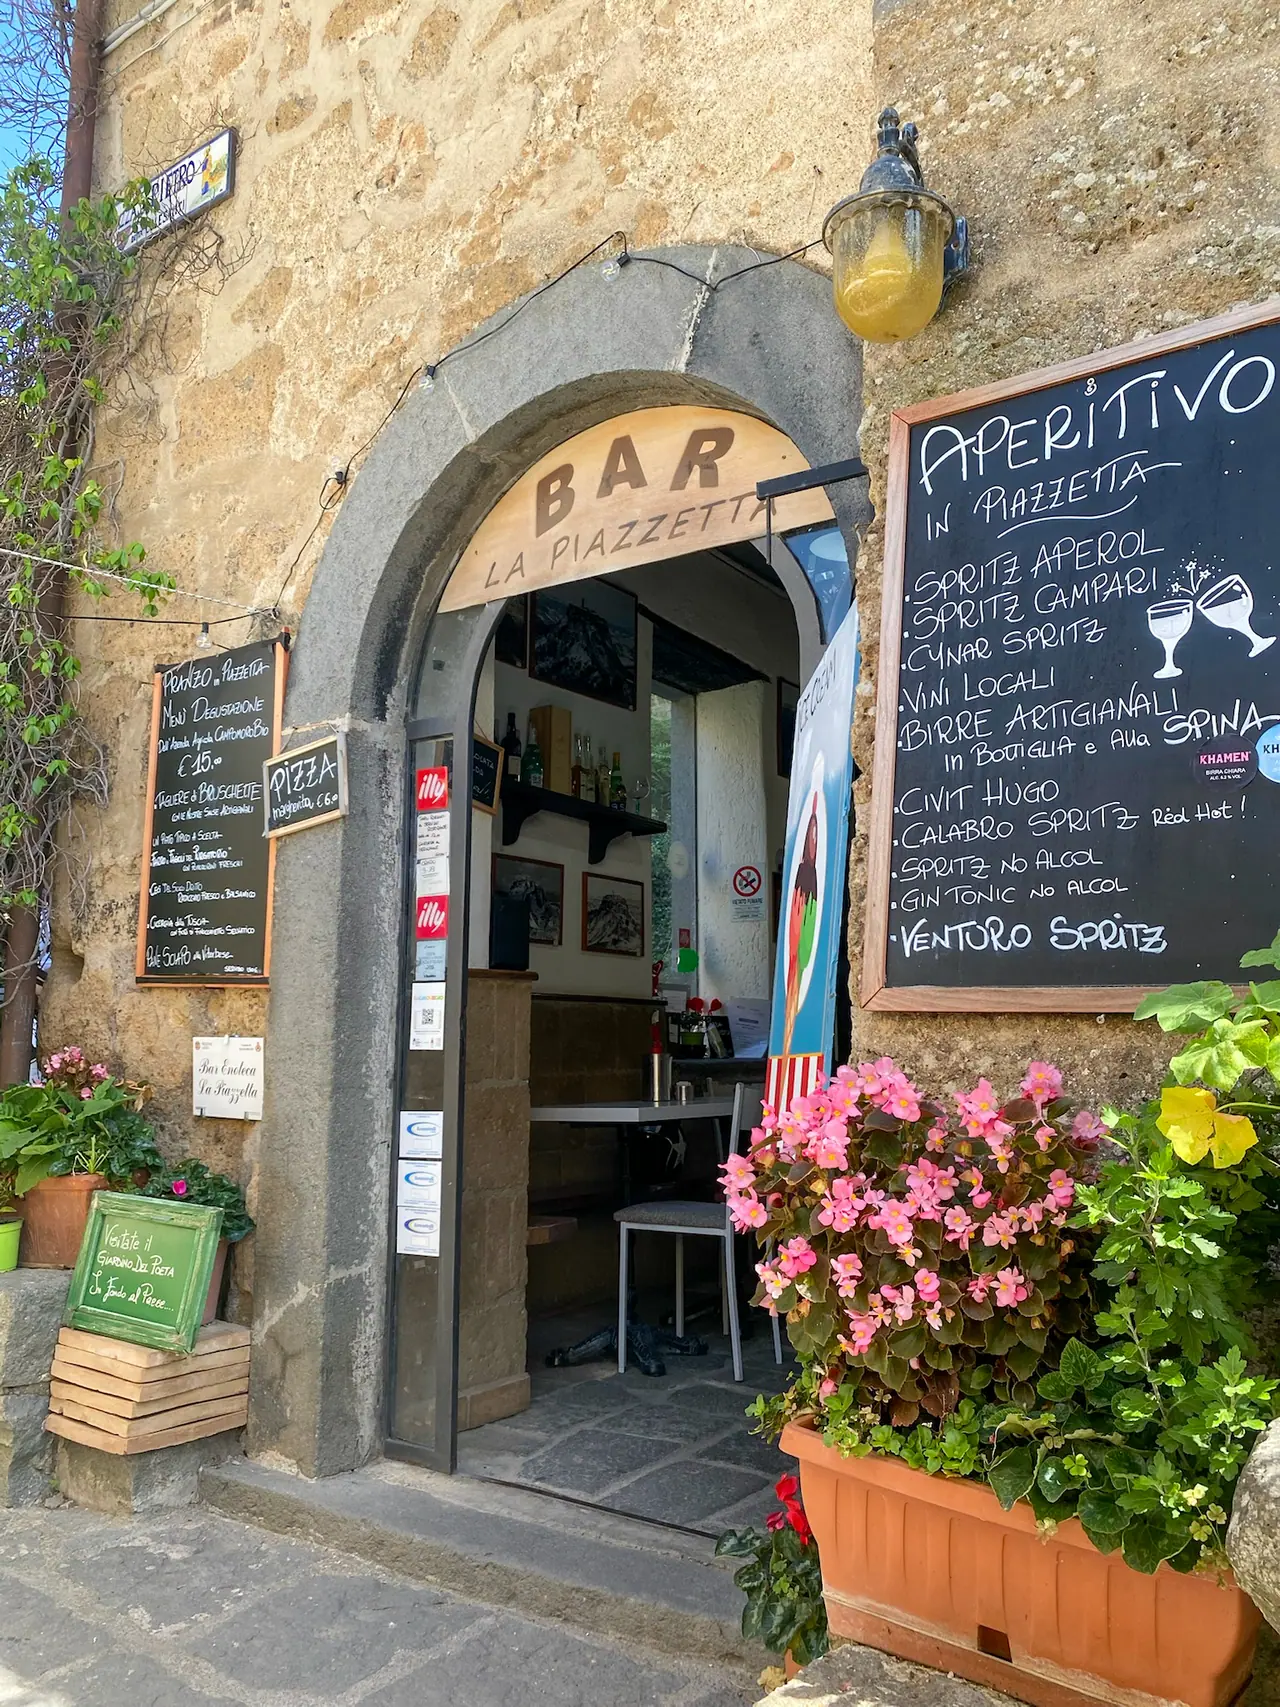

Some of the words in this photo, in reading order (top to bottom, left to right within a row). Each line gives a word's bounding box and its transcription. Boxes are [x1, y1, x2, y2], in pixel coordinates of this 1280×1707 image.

[151, 160, 196, 202] PIETRO
[920, 350, 1276, 494] APERITIVO
[536, 427, 735, 539] BAR
[927, 503, 952, 541] IN
[974, 450, 1183, 523] PIAZZETTA
[484, 552, 526, 590] LA
[550, 490, 778, 570] PIAZZETTA
[913, 552, 1023, 604] SPRITZ
[1030, 529, 1165, 578] APEROL
[913, 592, 1025, 640] SPRITZ
[1034, 567, 1158, 613] CAMPARI
[907, 638, 993, 672] CYNAR
[1002, 616, 1108, 655] SPRITZ
[163, 661, 213, 698] PRANZO
[221, 658, 270, 682] PIAZZETTA
[903, 677, 950, 713] VINI
[963, 666, 1055, 701] LOCALI
[191, 696, 265, 723] DEGUSTAZIONE
[901, 708, 994, 752] BIRRE
[1006, 681, 1178, 735] ARTIGIANALI
[1085, 742, 1098, 754] e
[1163, 698, 1280, 745] SPINA
[269, 752, 337, 802] PIZZA
[1199, 750, 1251, 765] KHAMEN
[418, 773, 446, 805] illy
[899, 785, 973, 816] CIVIT
[982, 778, 1060, 807] HUGO
[901, 816, 1014, 849] CALABRO
[1028, 801, 1140, 837] SPRITZ
[1195, 800, 1232, 822] Hot
[899, 854, 992, 883] SPRITZ
[1001, 853, 1028, 875] NO
[1035, 848, 1103, 869] ALCOL
[418, 901, 446, 933] illy
[901, 886, 940, 912] GIN
[944, 885, 1016, 906] TONIC
[1067, 878, 1129, 895] ALCOL
[901, 916, 1032, 958] VENTURO
[1050, 912, 1168, 955] SPRITZ
[199, 1057, 218, 1075] Bar
[221, 1058, 257, 1077] Enoteca
[199, 1078, 212, 1095] La
[104, 1223, 140, 1251] Visitate
[144, 1235, 153, 1251] il
[97, 1251, 133, 1269] GIARDINO
[132, 1255, 149, 1274] DEL
[150, 1255, 174, 1278] POETA
